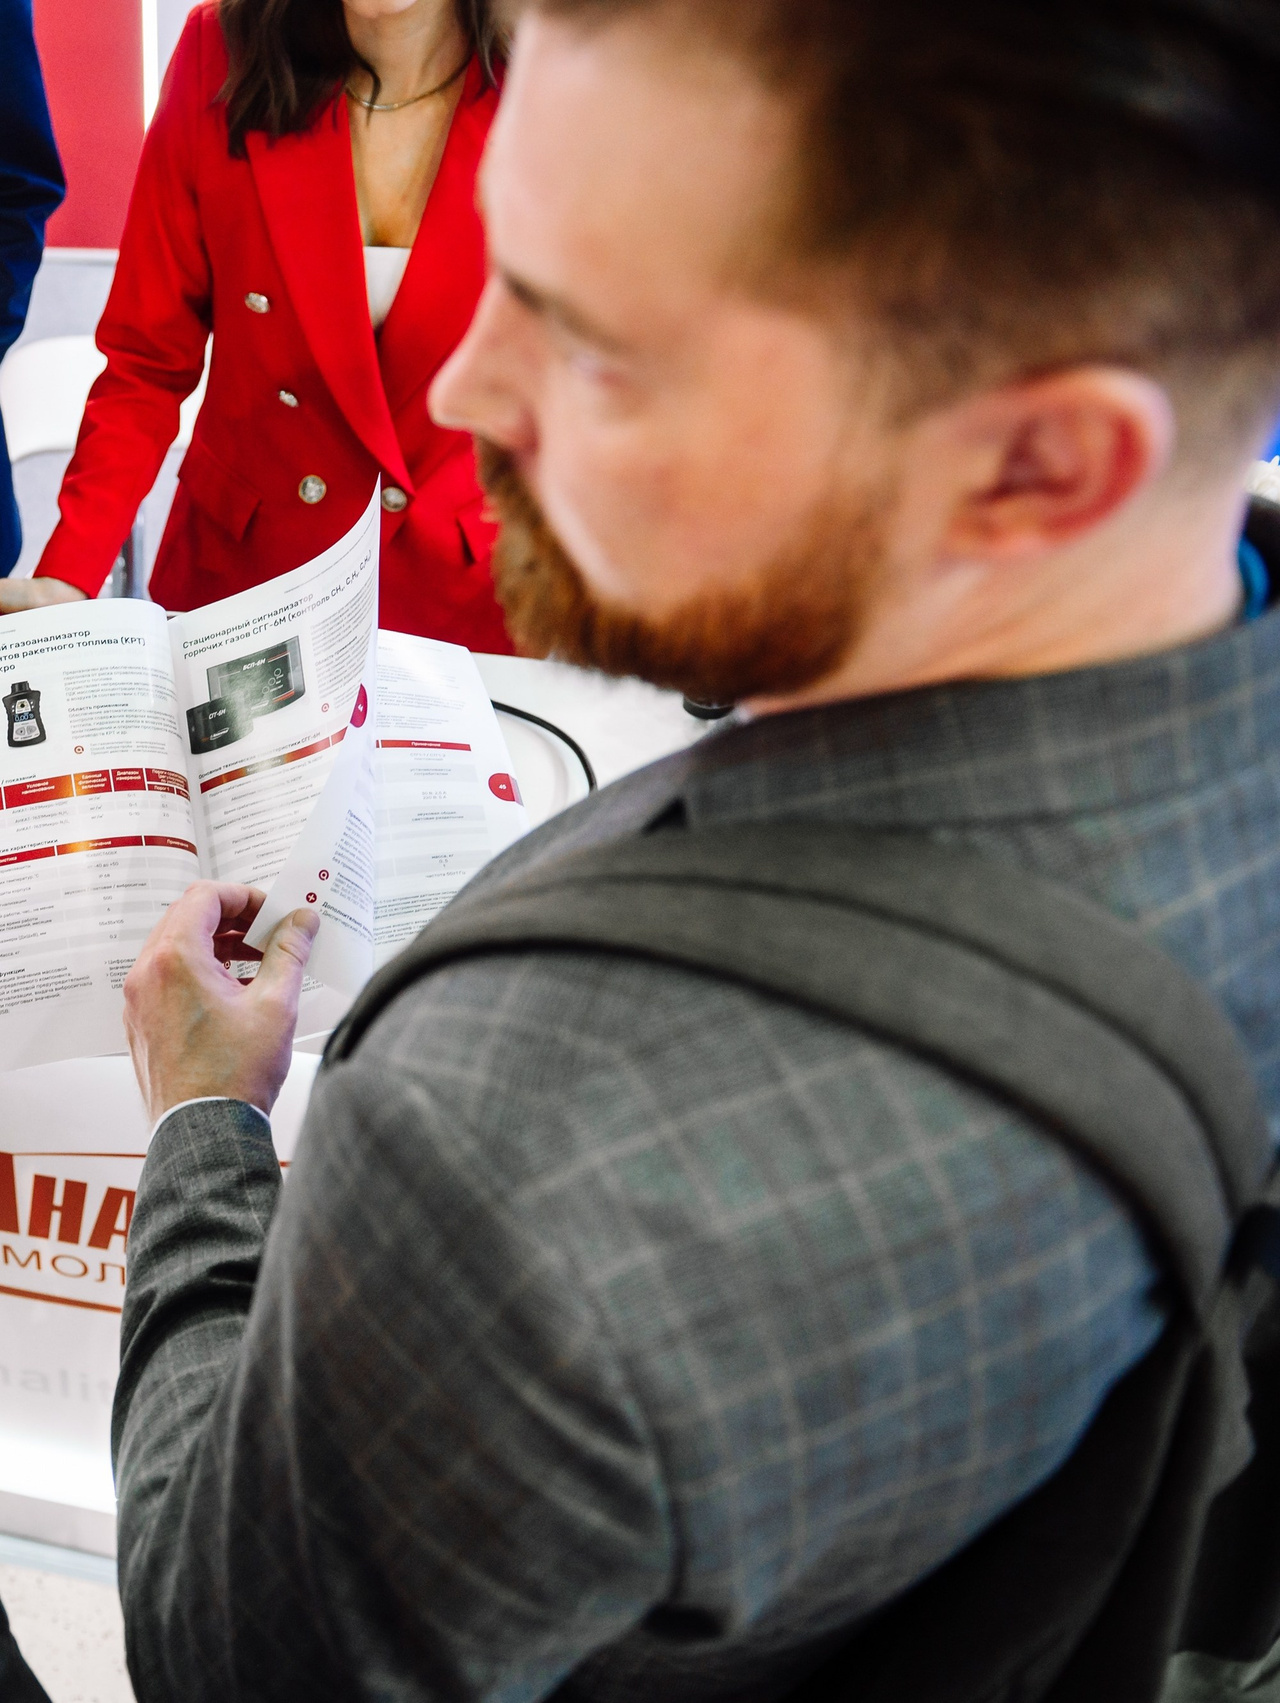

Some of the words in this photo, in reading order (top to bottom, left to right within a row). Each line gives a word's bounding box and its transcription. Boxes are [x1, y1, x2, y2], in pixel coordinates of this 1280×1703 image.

[9, 630, 91, 649] газоанализатор
[182, 619, 251, 649] Стационарный
[251, 593, 314, 626] сигнализатор
[184, 640, 224, 660] горючих
[224, 631, 251, 646] газов
[252, 616, 287, 635] СГГ-6М
[288, 594, 331, 622] (контроль
[22, 643, 74, 658] ракетного
[76, 638, 119, 648] топлива
[120, 636, 146, 646] (КРТ)
